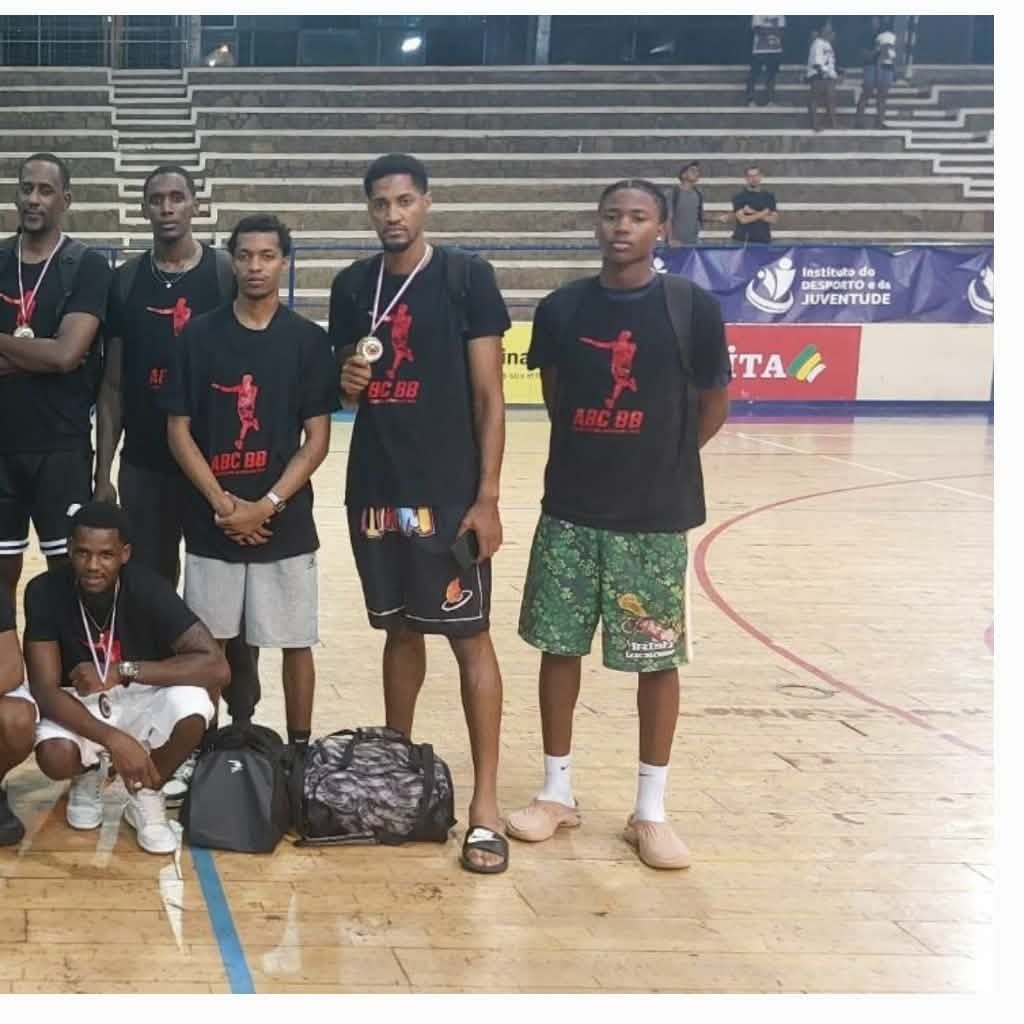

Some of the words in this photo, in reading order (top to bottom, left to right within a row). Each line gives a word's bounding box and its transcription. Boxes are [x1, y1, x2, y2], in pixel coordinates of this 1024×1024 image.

[801, 264, 856, 277] Instituto
[858, 264, 876, 277] do
[801, 279, 865, 291] DESPORTO
[867, 281, 876, 291] e
[877, 279, 892, 291] da
[801, 293, 892, 305] JUVENTUDE
[393, 379, 420, 398] BB
[572, 409, 610, 427] ABC
[614, 409, 645, 429] BB
[210, 452, 241, 472] ABC
[243, 449, 268, 469] BB
